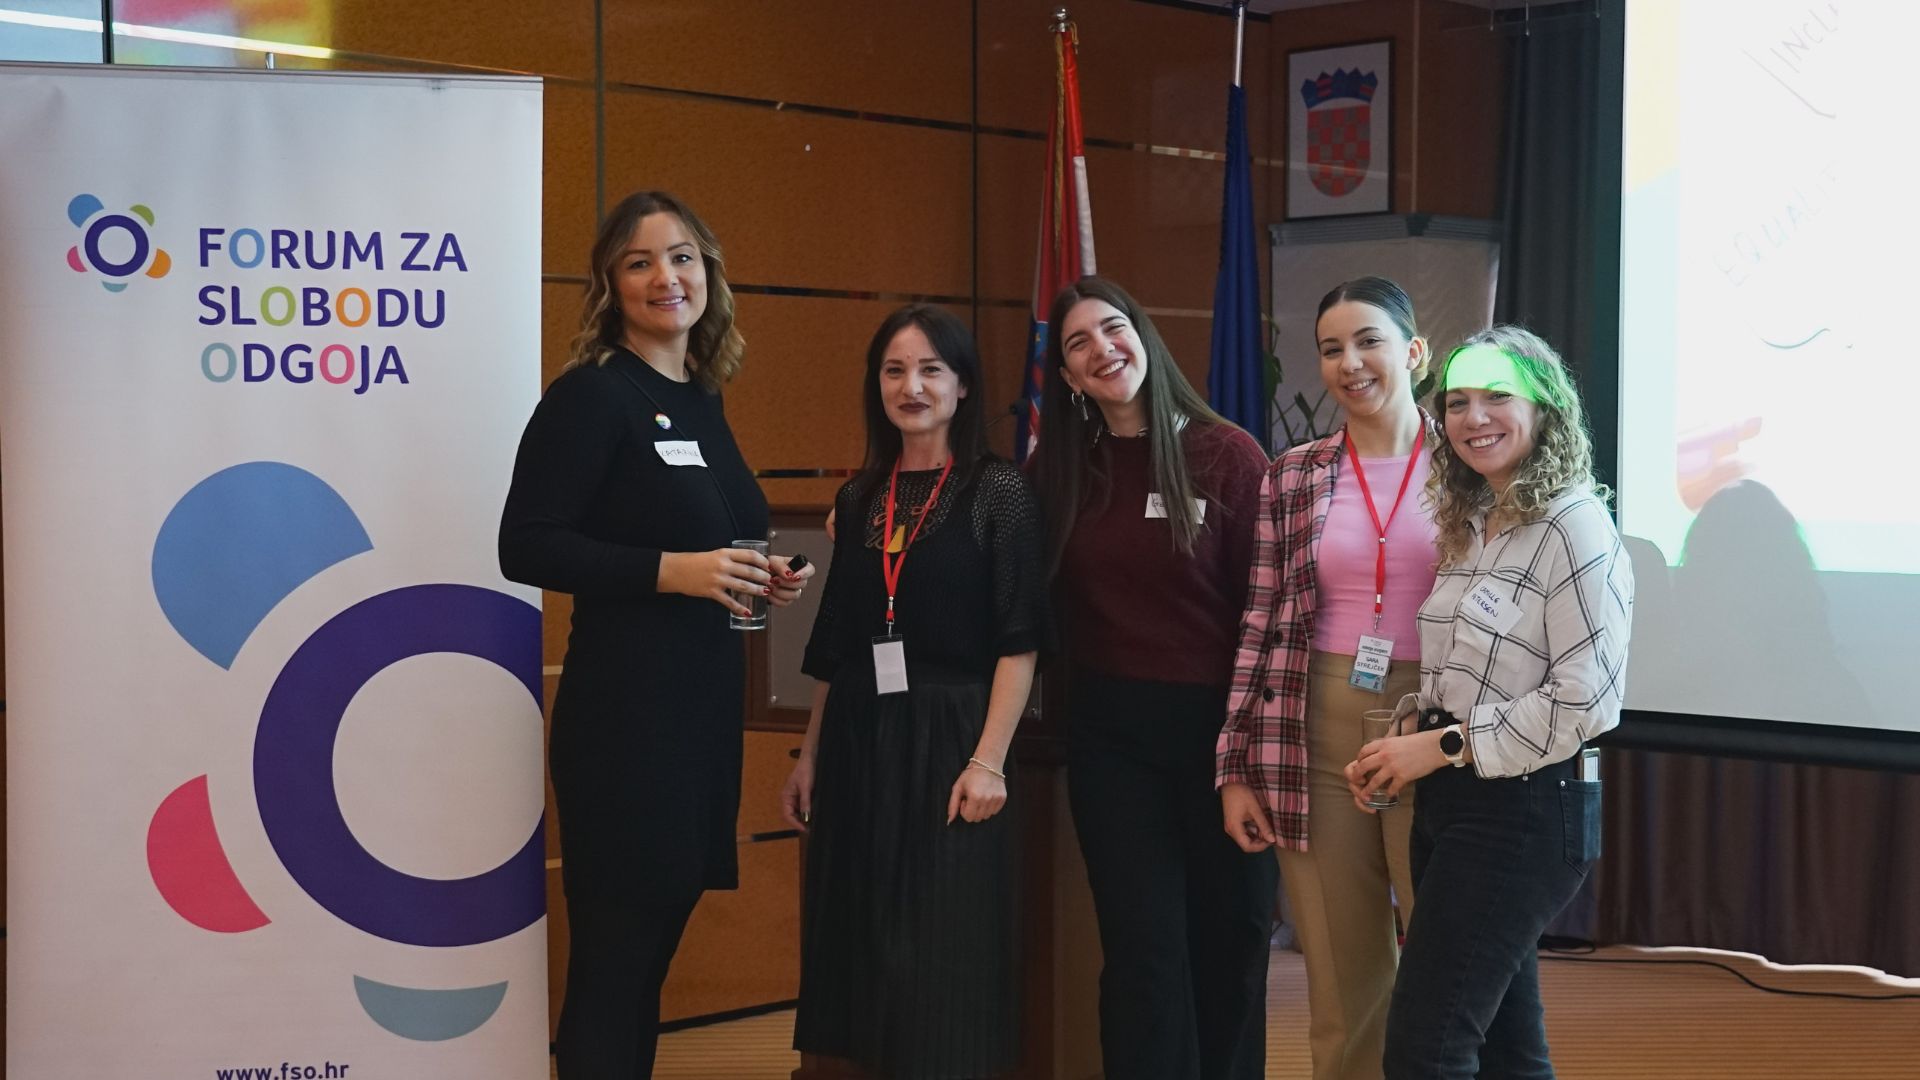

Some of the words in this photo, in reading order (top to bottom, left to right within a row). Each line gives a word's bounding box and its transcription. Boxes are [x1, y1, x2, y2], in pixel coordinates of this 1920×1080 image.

[199, 228, 384, 270] FORUM
[400, 232, 468, 272] ZA
[198, 285, 446, 328] SLOBODU
[200, 342, 410, 395] ODGOJA
[1366, 656, 1379, 664] SARA
[216, 1061, 349, 1080] www.fso.hr
